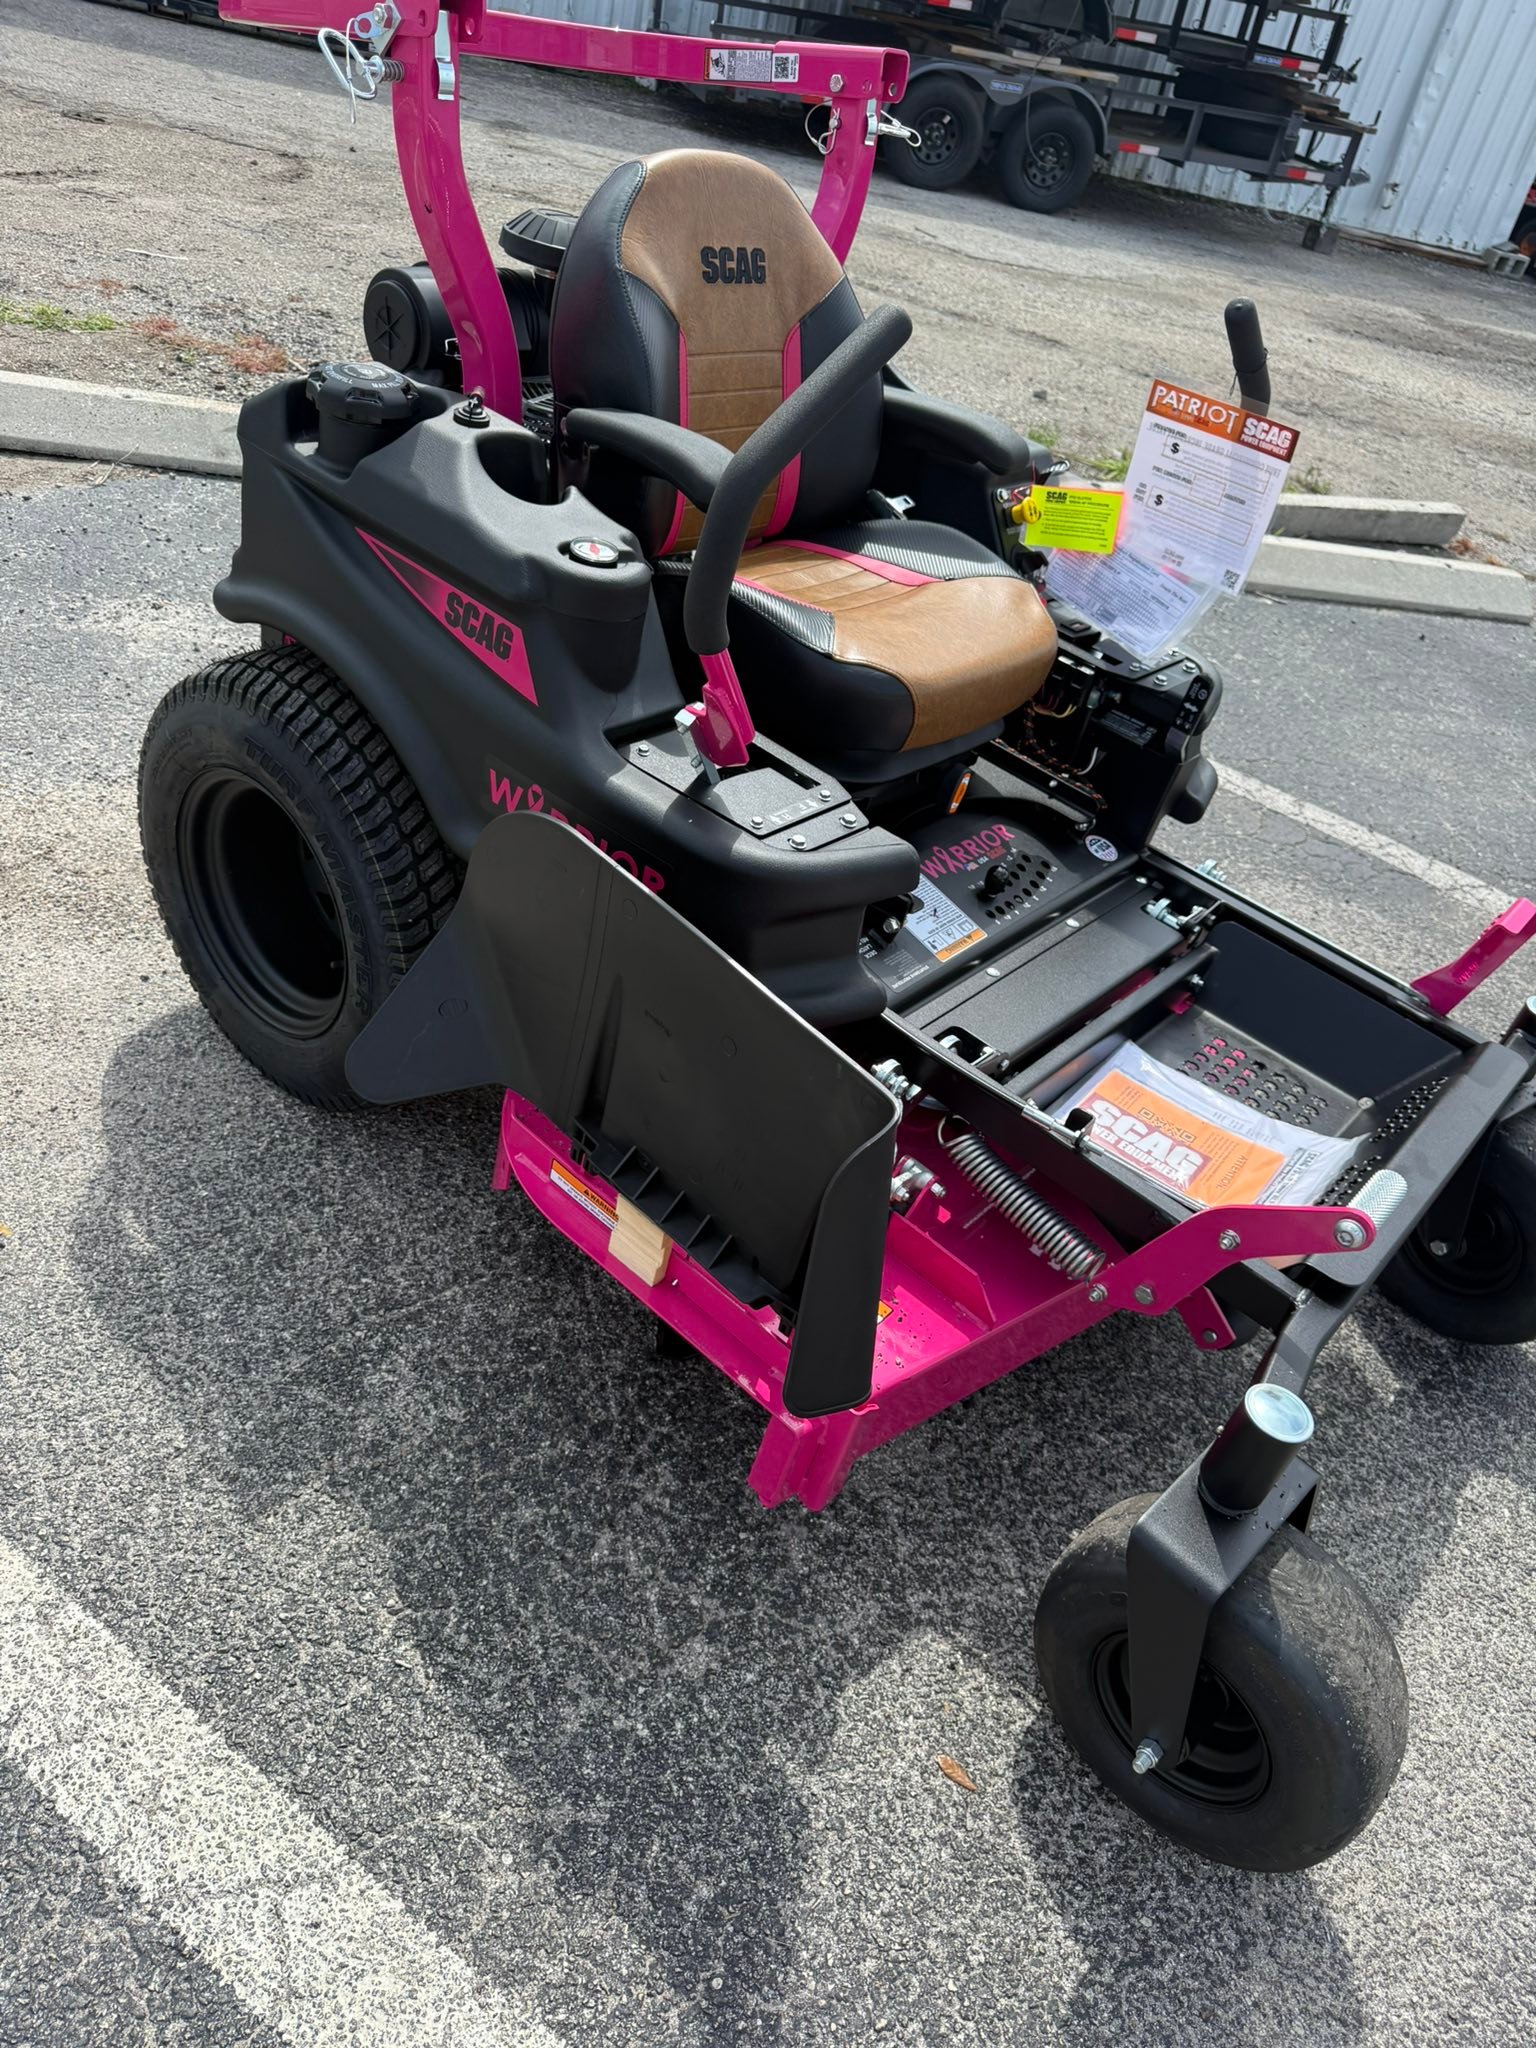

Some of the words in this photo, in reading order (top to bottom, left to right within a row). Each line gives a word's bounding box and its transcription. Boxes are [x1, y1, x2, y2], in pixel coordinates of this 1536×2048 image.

[700, 246, 766, 284] SCAG
[1152, 385, 1240, 434] PATRIOT
[1243, 417, 1293, 449] SCAG
[1046, 491, 1068, 500] SCAG
[444, 591, 514, 661] SCAG
[242, 734, 321, 826] TURF
[315, 831, 376, 1016] MASTER
[920, 824, 1016, 879] WARRIOR
[1091, 1100, 1204, 1177] SCAG
